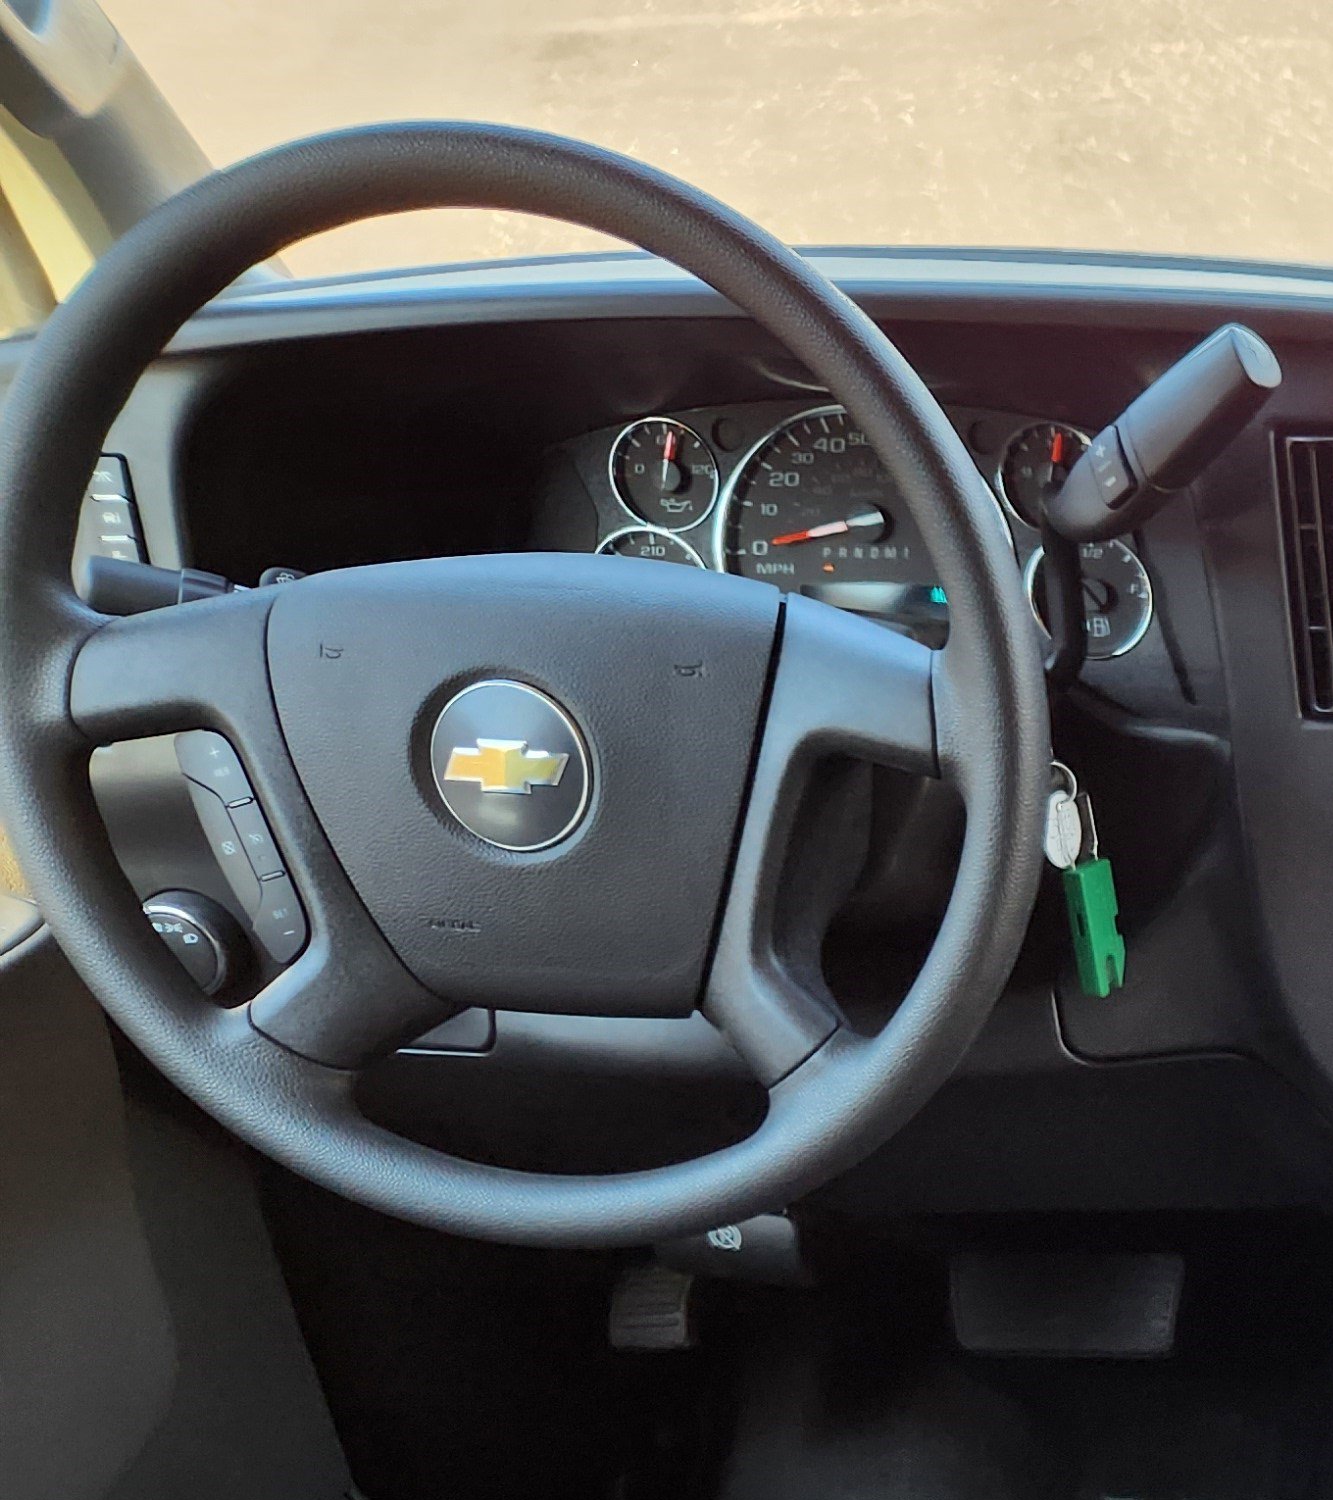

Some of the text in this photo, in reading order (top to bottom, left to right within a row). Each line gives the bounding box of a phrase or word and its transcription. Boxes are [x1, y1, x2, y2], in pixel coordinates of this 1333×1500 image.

[814, 437, 846, 454] 40
[792, 452, 815, 465] 30
[769, 472, 800, 488] 20
[760, 503, 778, 517] 10
[640, 546, 666, 557] 210
[752, 540, 769, 556] 0
[756, 562, 796, 575] MPH
